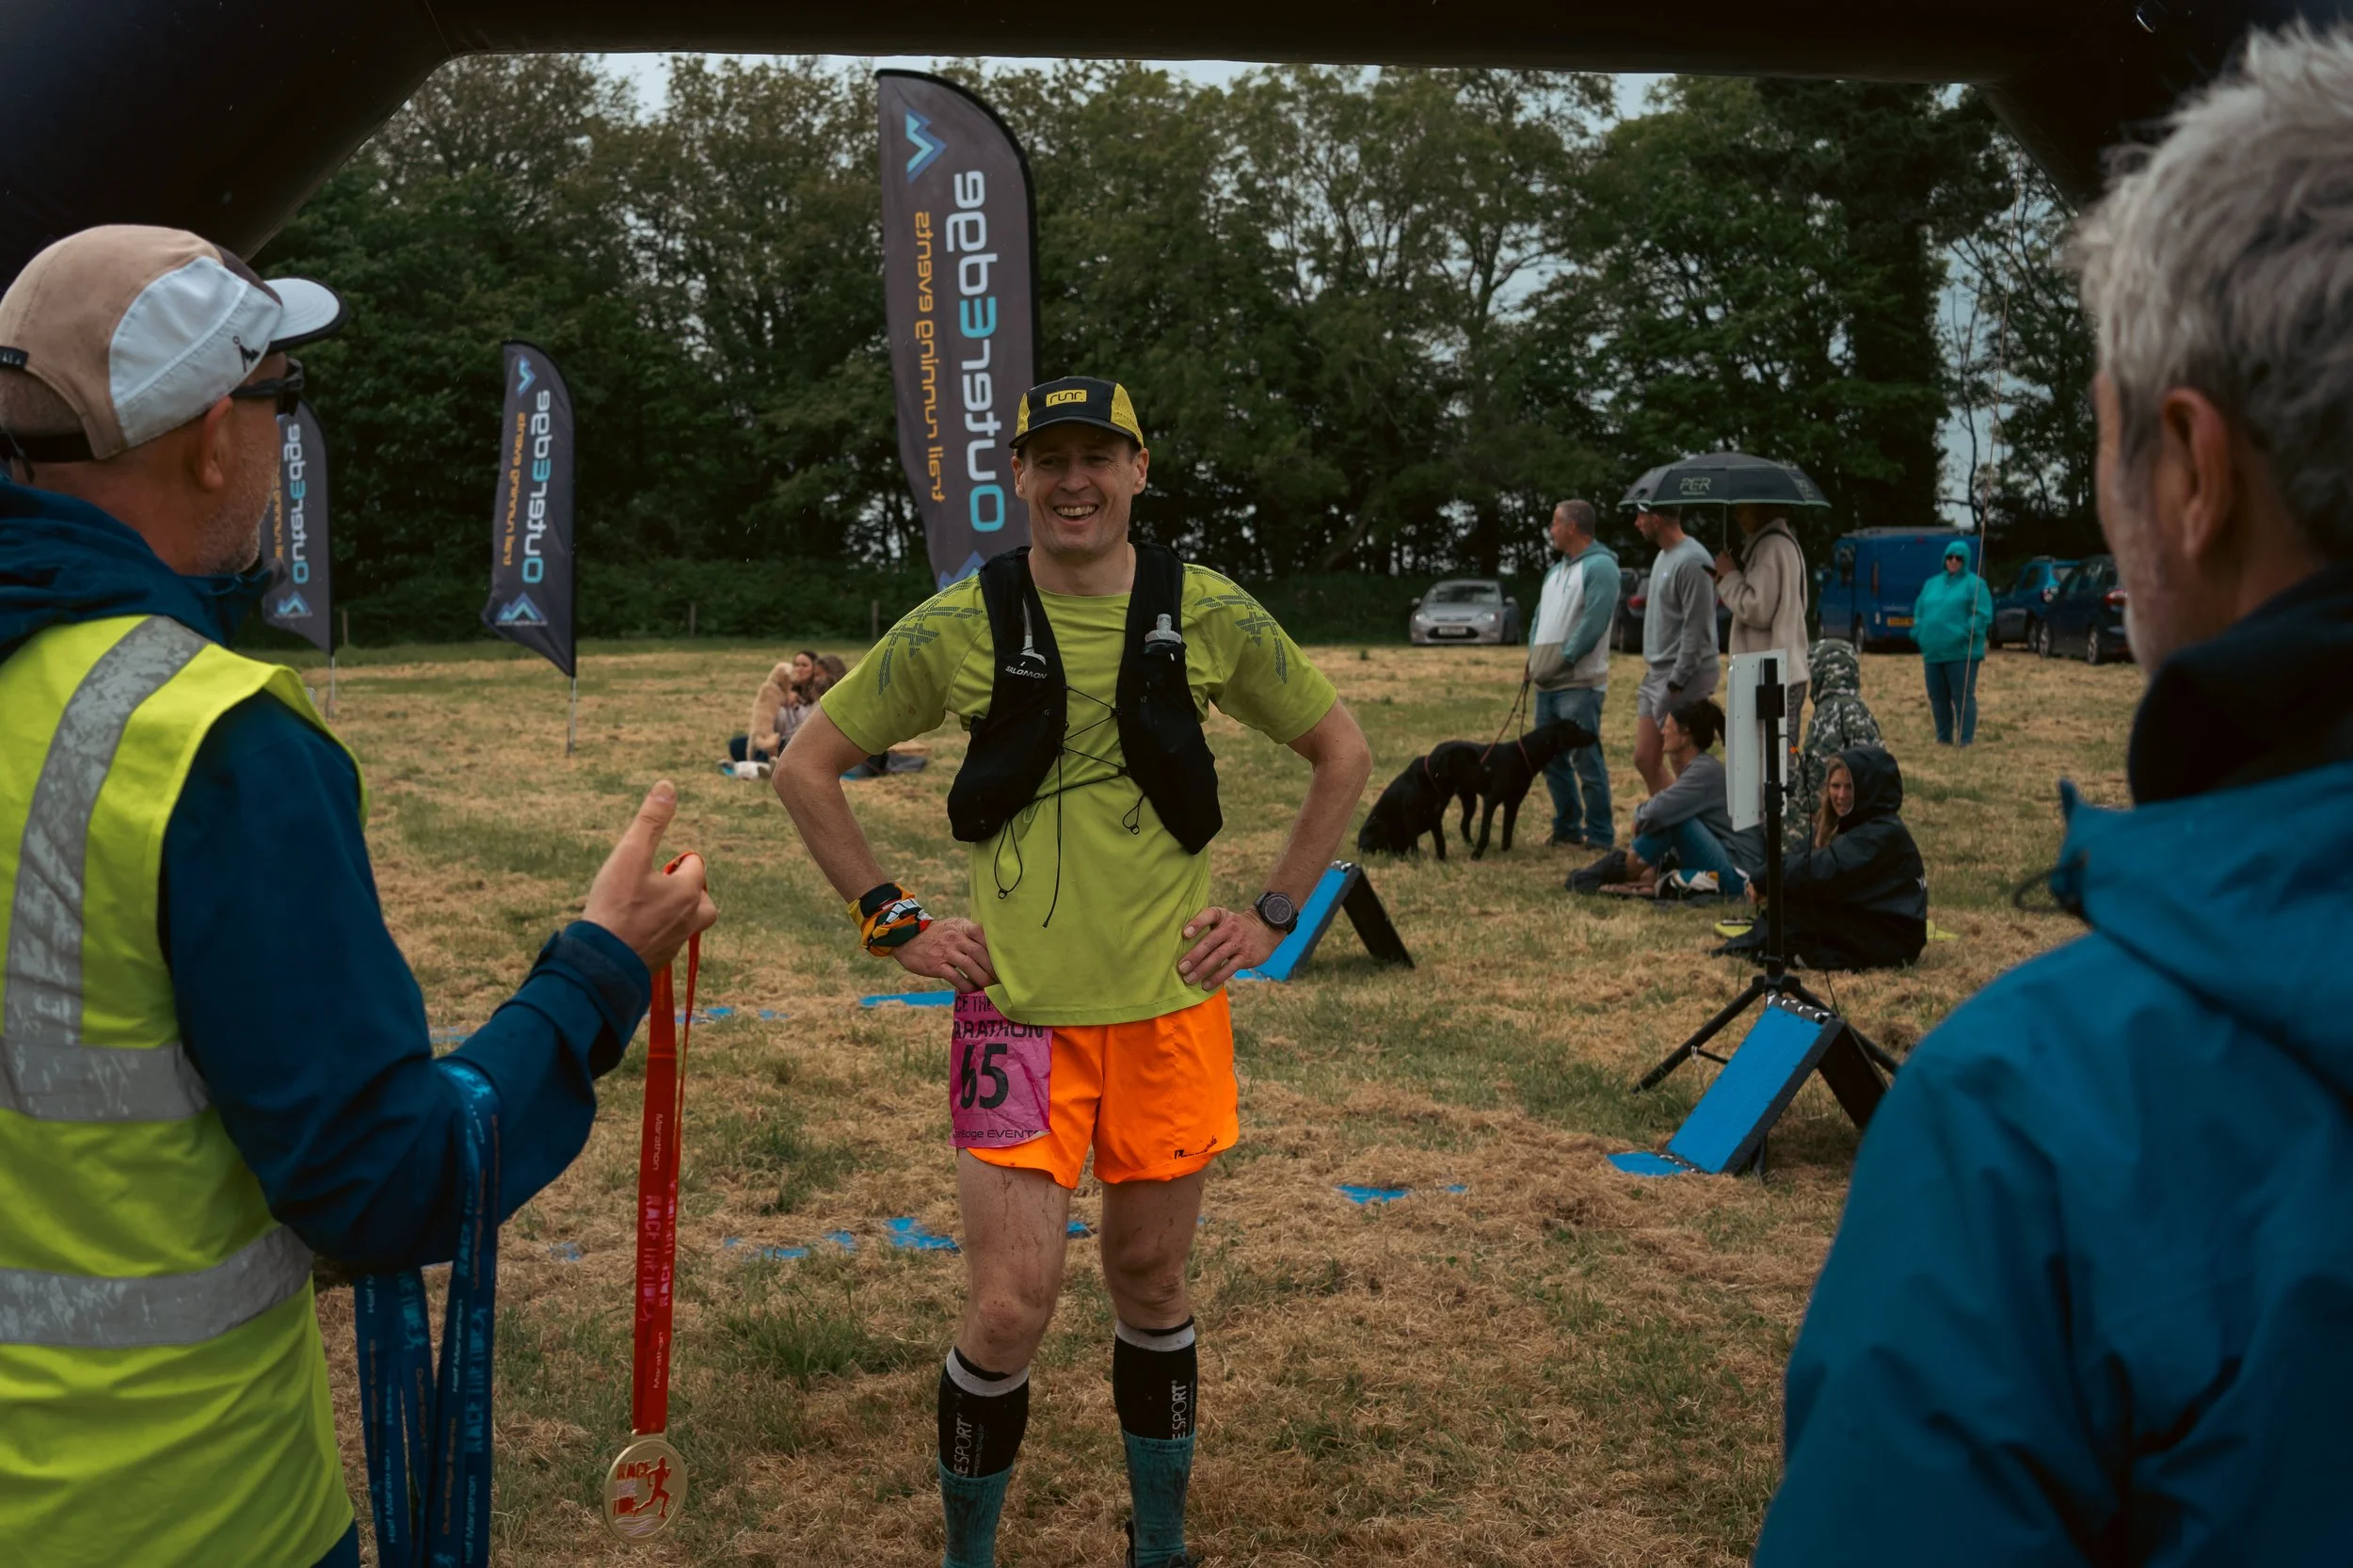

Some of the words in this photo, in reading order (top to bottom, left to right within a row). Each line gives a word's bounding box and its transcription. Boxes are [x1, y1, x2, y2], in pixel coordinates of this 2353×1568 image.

[1004, 665, 1048, 680] SALOMON
[959, 1043, 1009, 1110] 65
[653, 1113, 663, 1170] Marathon
[616, 1460, 651, 1479] RACE
[465, 1475, 477, 1539] Marathon
